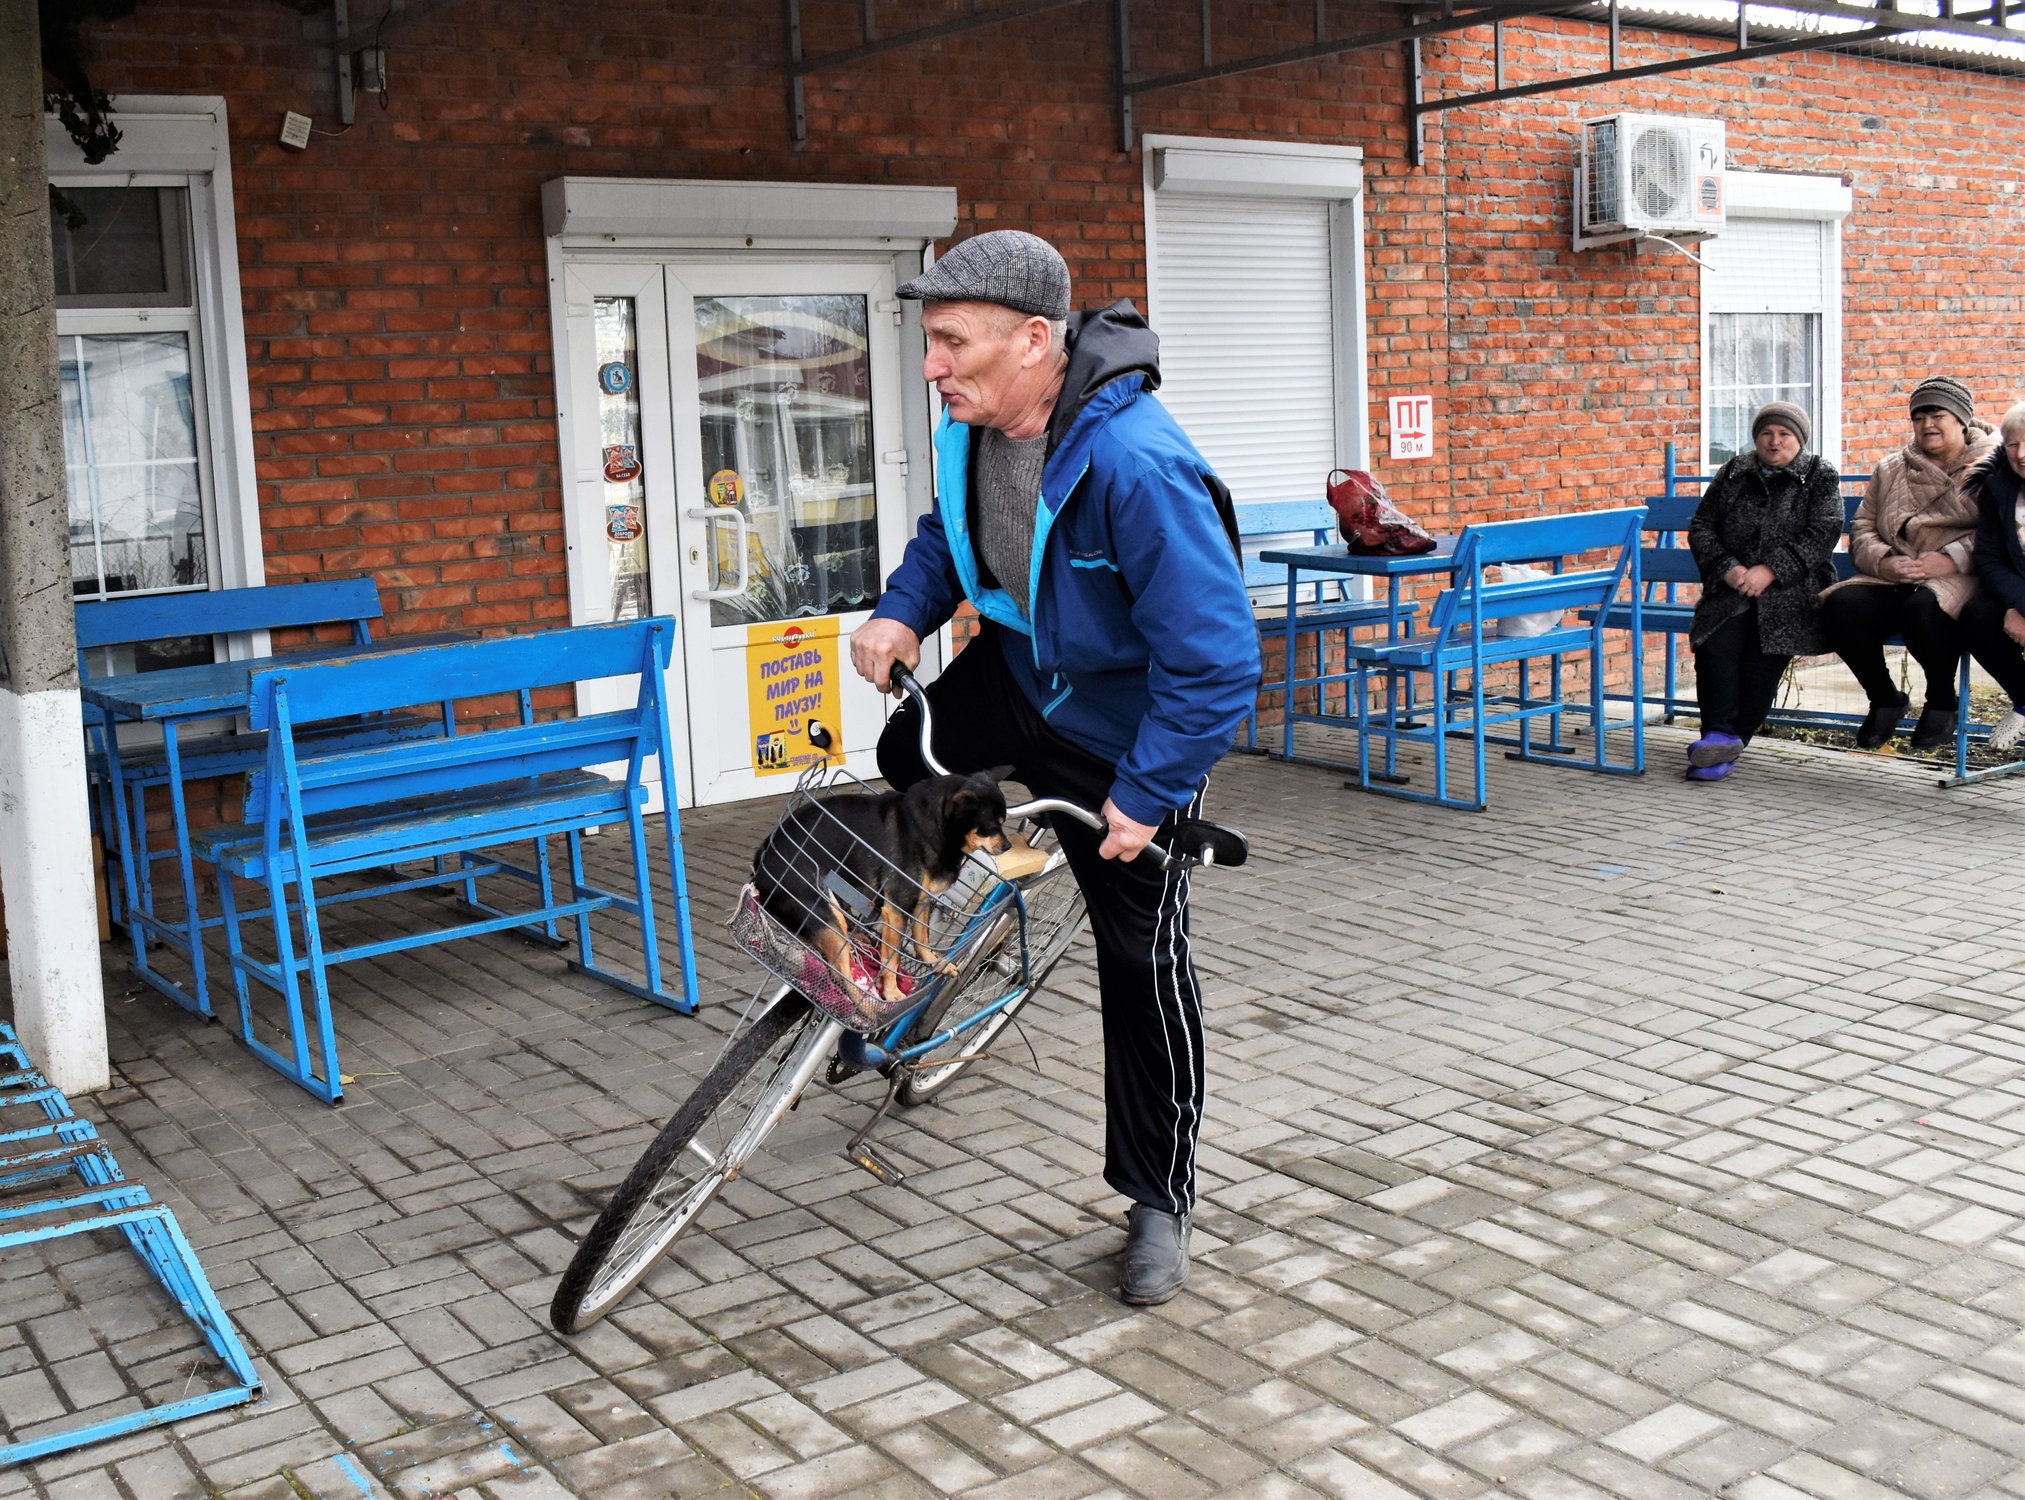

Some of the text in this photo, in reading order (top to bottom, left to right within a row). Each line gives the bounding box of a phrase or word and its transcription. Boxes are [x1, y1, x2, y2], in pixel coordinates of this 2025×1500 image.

[1397, 400, 1428, 428] ПГ
[1400, 441, 1412, 453] 90
[760, 649, 822, 680] ПОСТАВЬ
[766, 670, 824, 701] МИР НА
[774, 692, 822, 721] ПАУЗУ!
